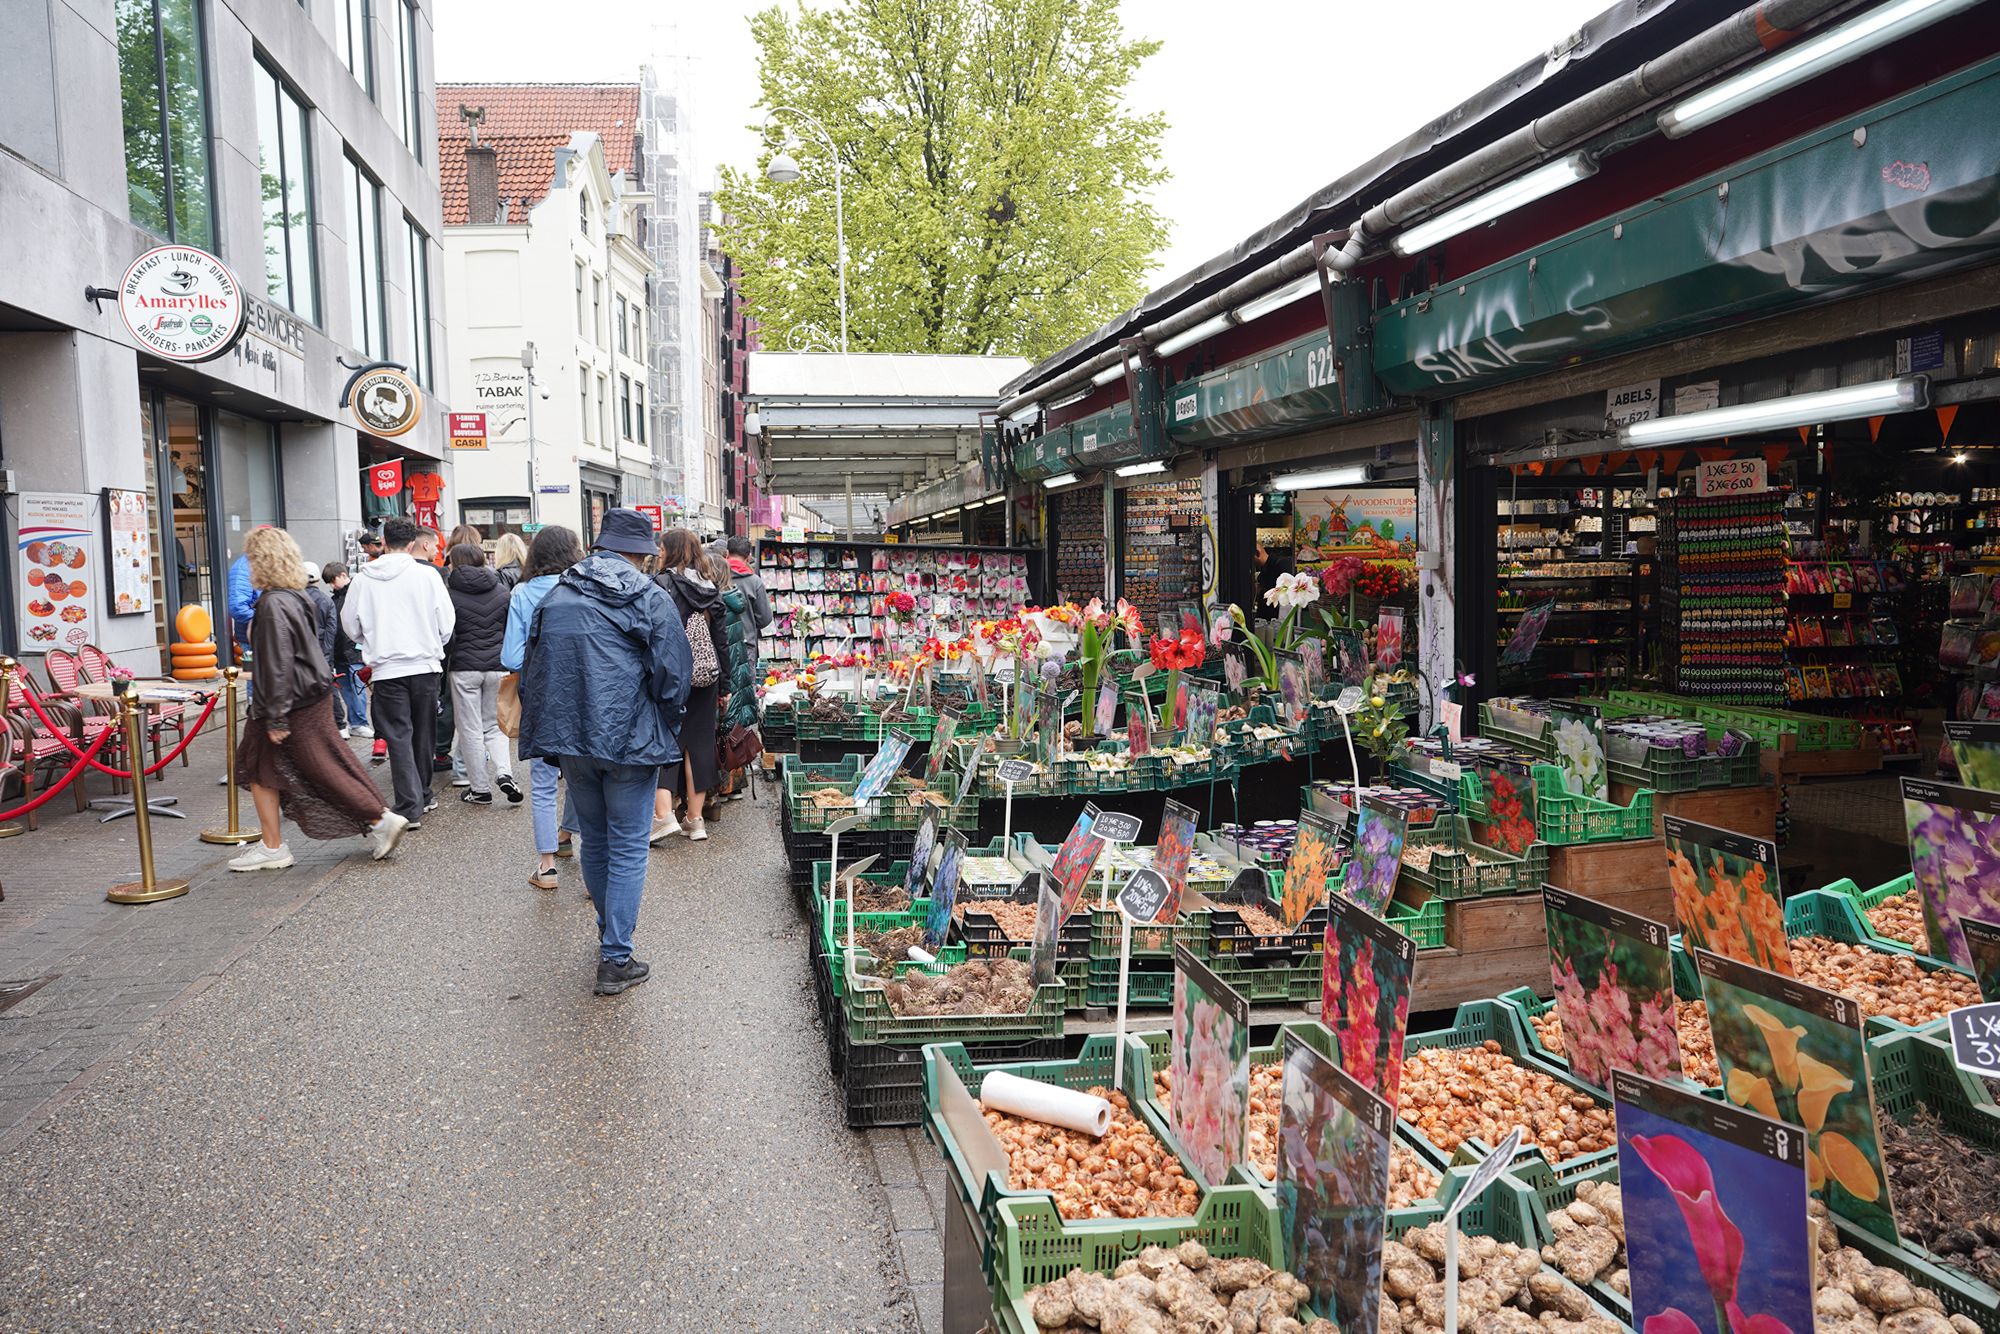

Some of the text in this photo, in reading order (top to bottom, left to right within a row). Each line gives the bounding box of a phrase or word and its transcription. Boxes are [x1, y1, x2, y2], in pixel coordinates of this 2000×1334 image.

[125, 252, 234, 296] BREAKFAST LUNCH DINNER
[135, 293, 227, 312] Amarylles
[185, 324, 228, 353] PANCAKES
[1307, 345, 1336, 389] 622
[361, 376, 411, 396] HENRI WILLIG
[475, 386, 523, 397] TABAK
[1629, 410, 1650, 424] 622
[455, 439, 482, 447] CASH
[420, 512, 432, 526] 14
[1905, 786, 1939, 797] Kings Lynn
[1545, 893, 1554, 902] My
[1554, 896, 1567, 906] Love
[1966, 926, 1990, 939] Reine
